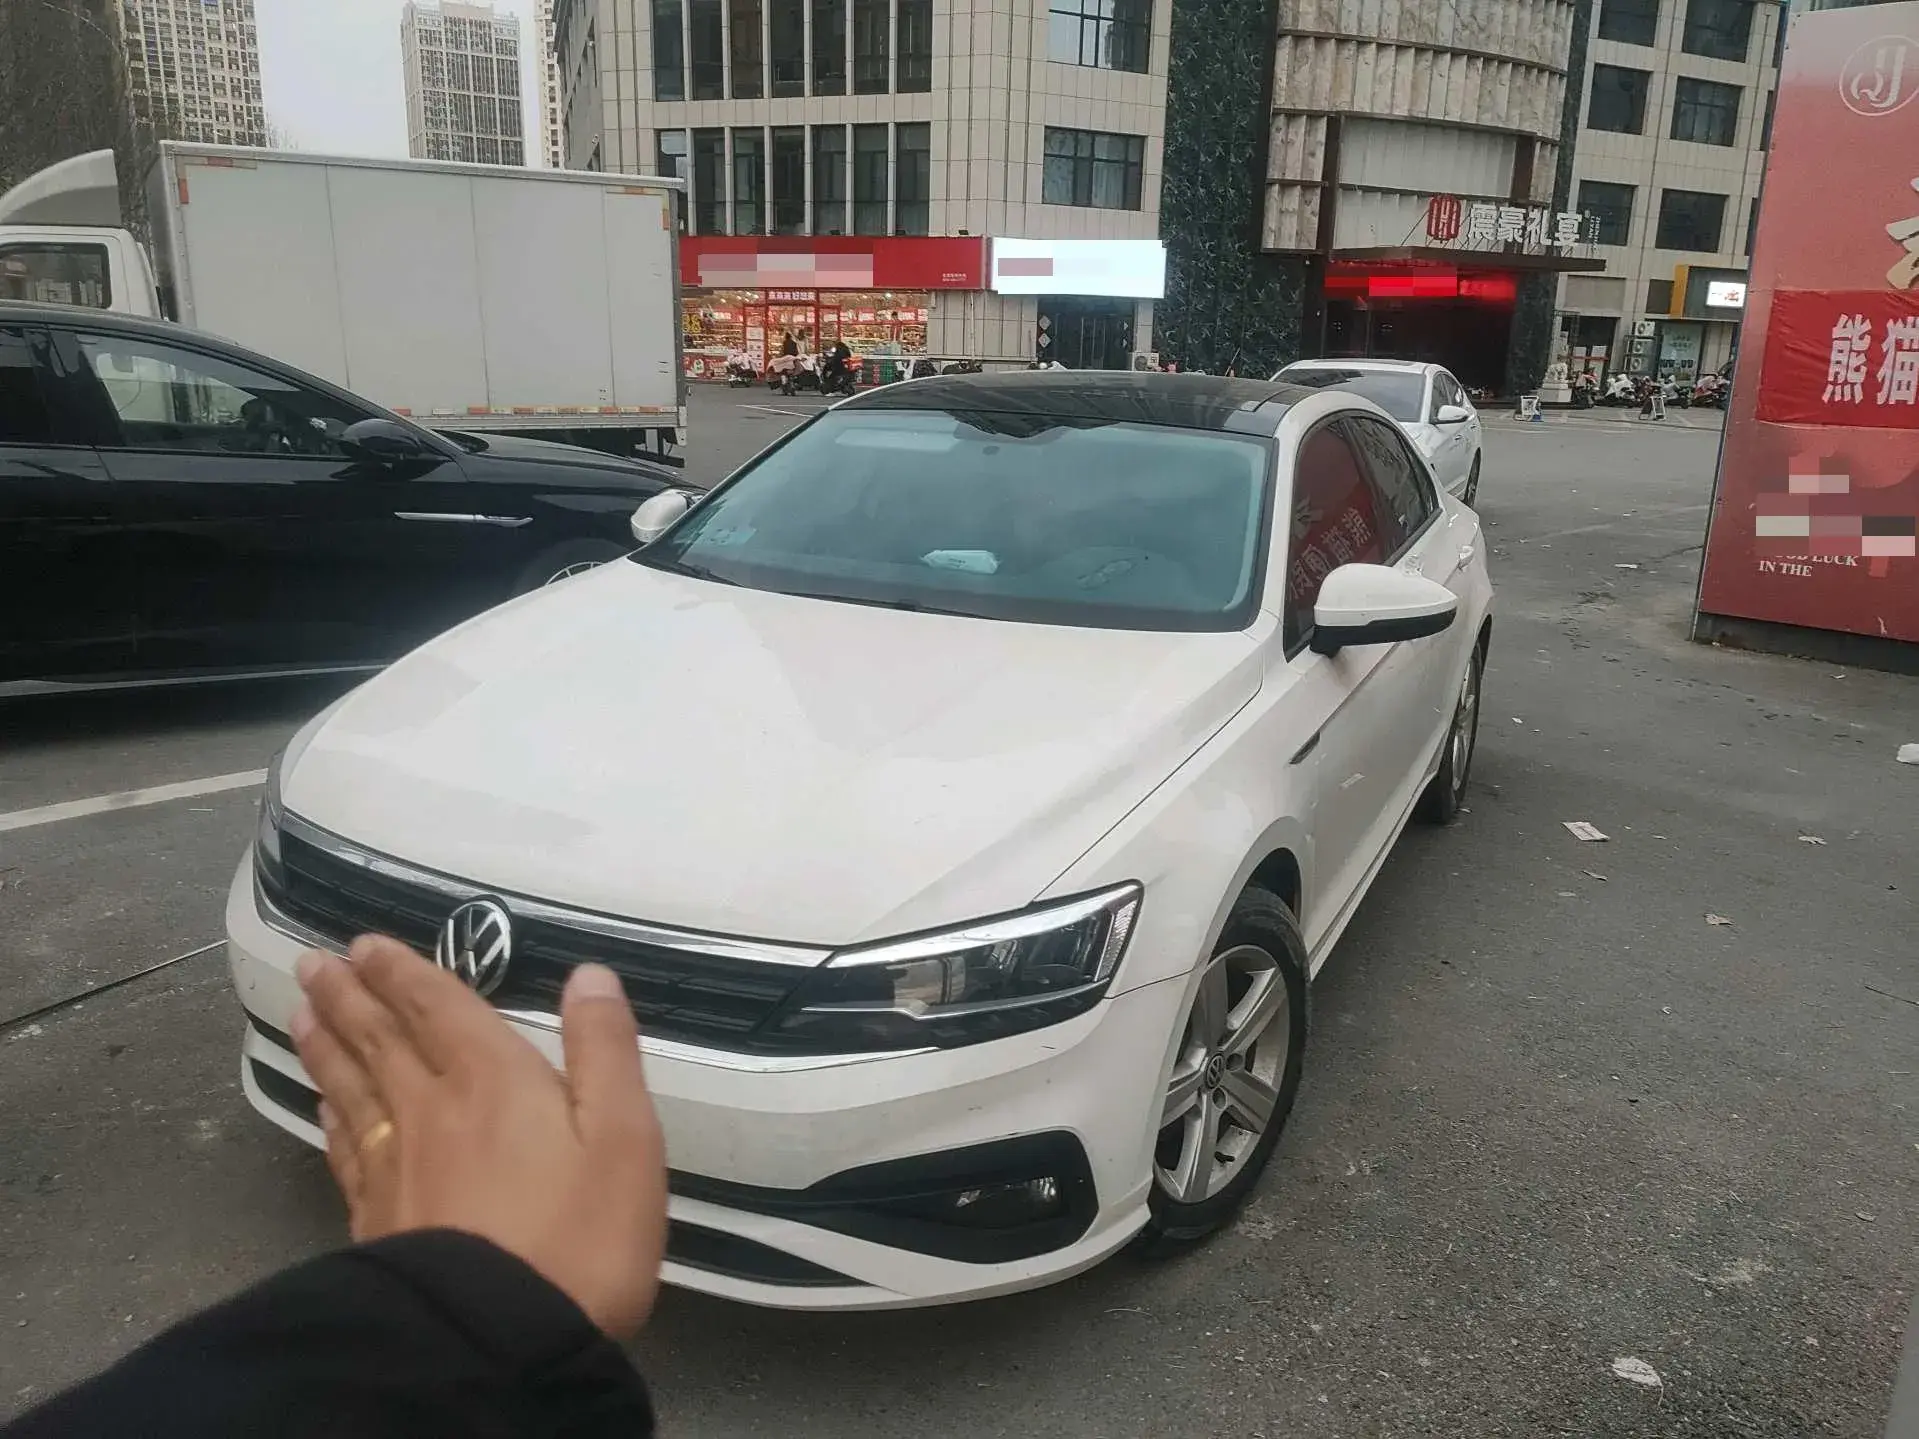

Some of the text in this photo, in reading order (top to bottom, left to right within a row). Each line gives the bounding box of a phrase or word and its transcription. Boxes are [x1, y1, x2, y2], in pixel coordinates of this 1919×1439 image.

[1822, 313, 1919, 405] 熊猫
[1759, 560, 1813, 577] IN THE
